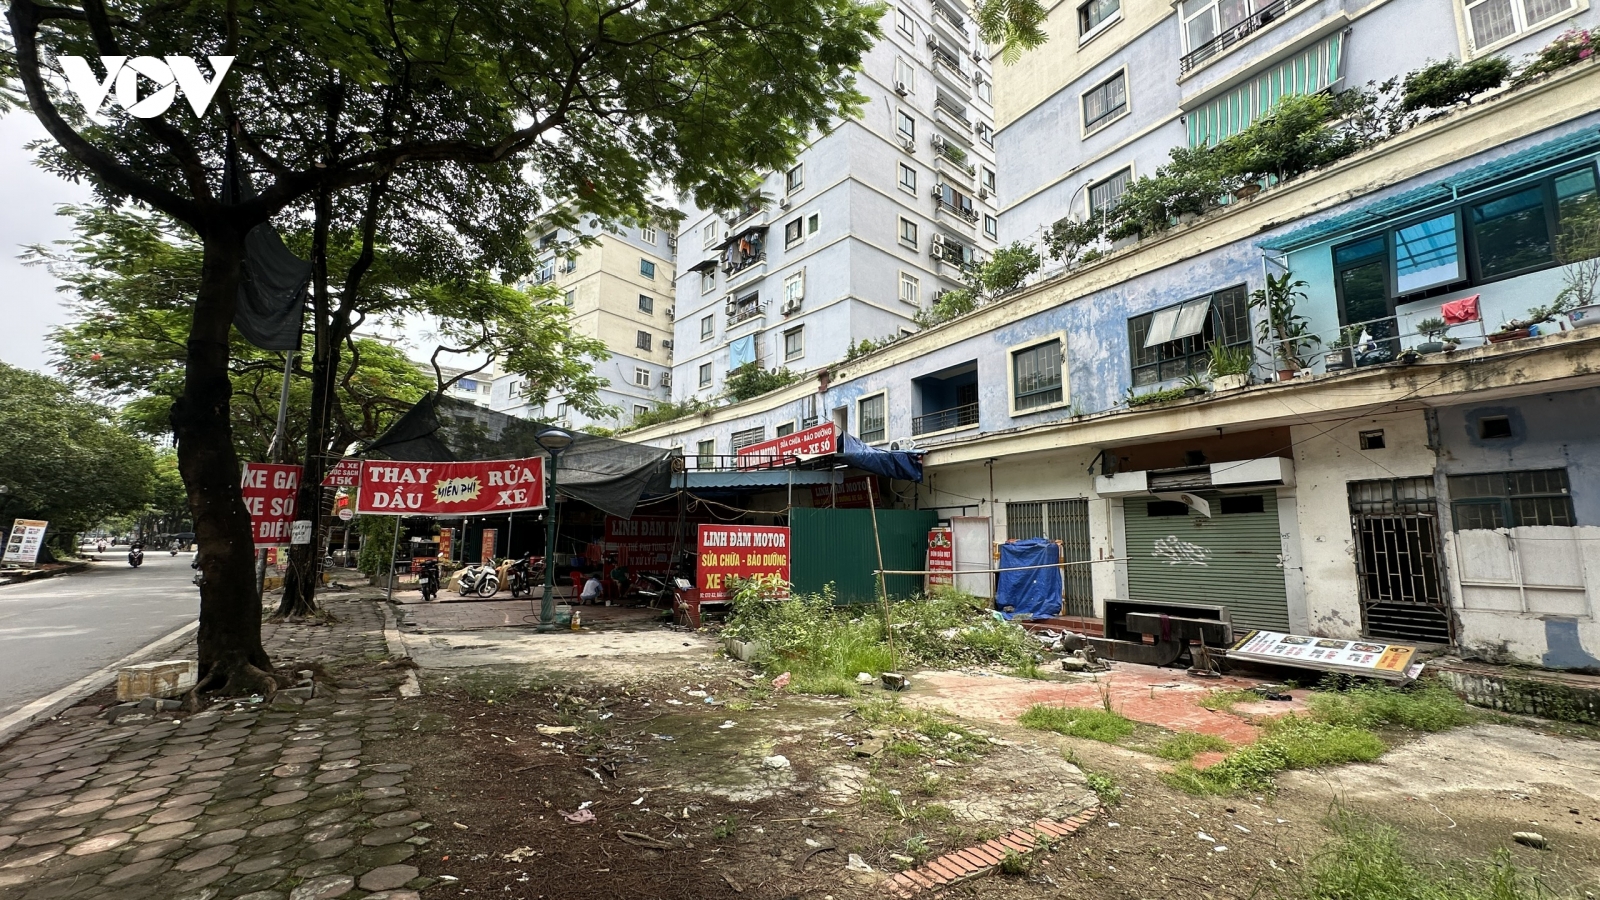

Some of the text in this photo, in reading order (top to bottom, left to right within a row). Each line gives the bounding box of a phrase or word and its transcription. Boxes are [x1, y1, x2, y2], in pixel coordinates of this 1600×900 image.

[804, 432, 814, 442] BẢO
[814, 427, 832, 439] DƯỠNG
[808, 443, 820, 454] XE
[820, 436, 830, 452] SỐ
[243, 469, 297, 490] XE GA
[330, 476, 353, 485] 15K
[368, 463, 536, 486] THAY RỬA
[460, 478, 477, 495] PHÍ
[845, 480, 868, 493] MOTO
[242, 491, 296, 517] XE SỐ
[371, 485, 528, 509] DẦU XE
[260, 518, 293, 541] ĐIỆN
[611, 518, 697, 537] LINH ĐÀM MTO
[703, 528, 786, 547] LINH ĐÀM MOTOR
[701, 550, 718, 566] SỬA
[719, 551, 740, 566] CHỮA
[747, 550, 762, 566] BẢO
[763, 551, 787, 566] DƯỠNG
[705, 573, 721, 589] XE
